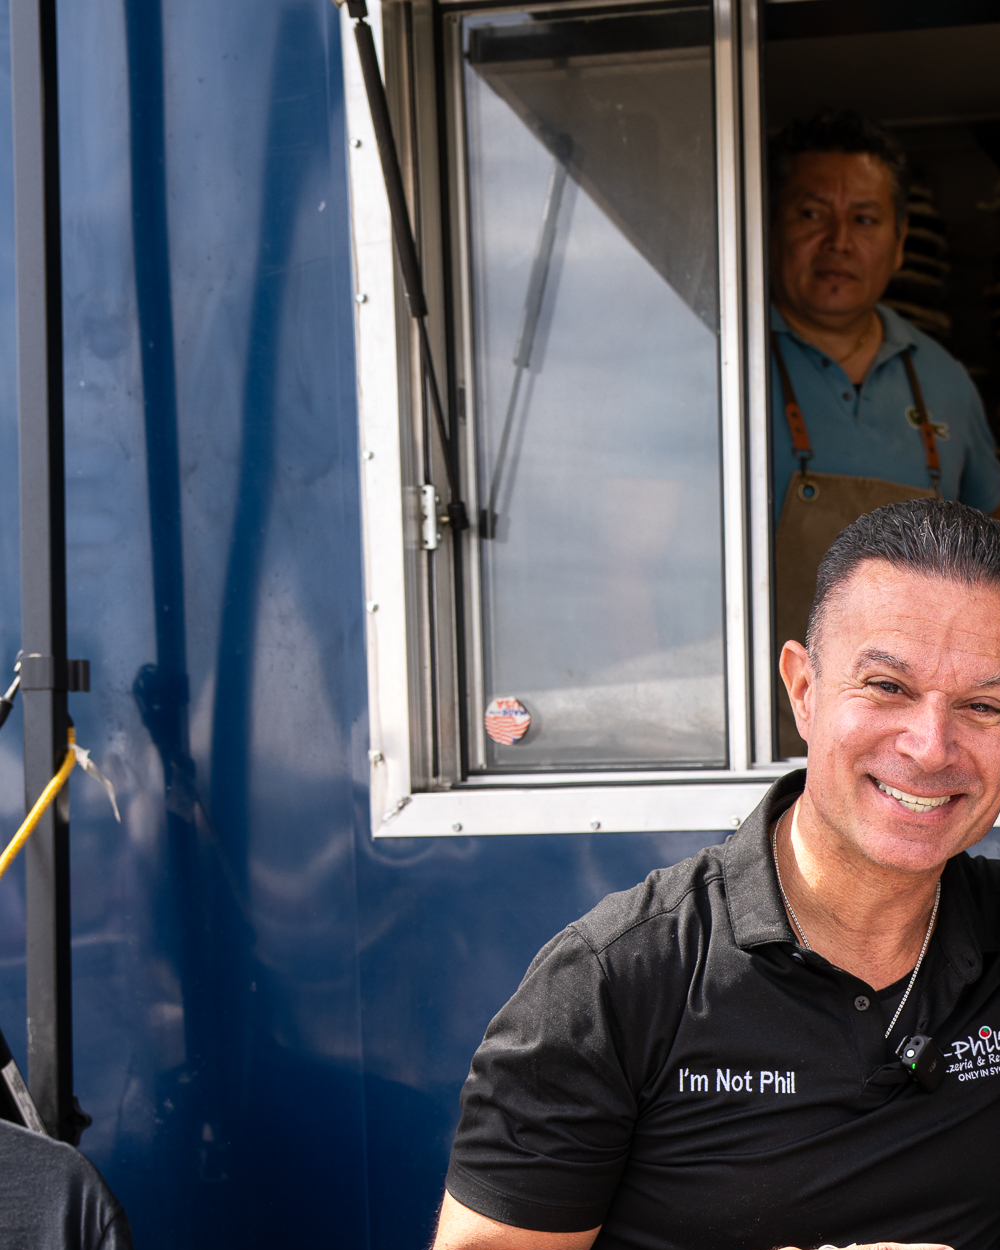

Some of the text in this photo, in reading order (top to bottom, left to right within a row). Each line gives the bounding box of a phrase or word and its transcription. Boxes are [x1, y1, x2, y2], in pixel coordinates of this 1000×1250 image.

[946, 1058, 973, 1073] zeria
[976, 1056, 986, 1067] &
[679, 1068, 797, 1094] I'm Not Phil
[958, 1070, 980, 1081] ONLY
[980, 1068, 989, 1077] IN
